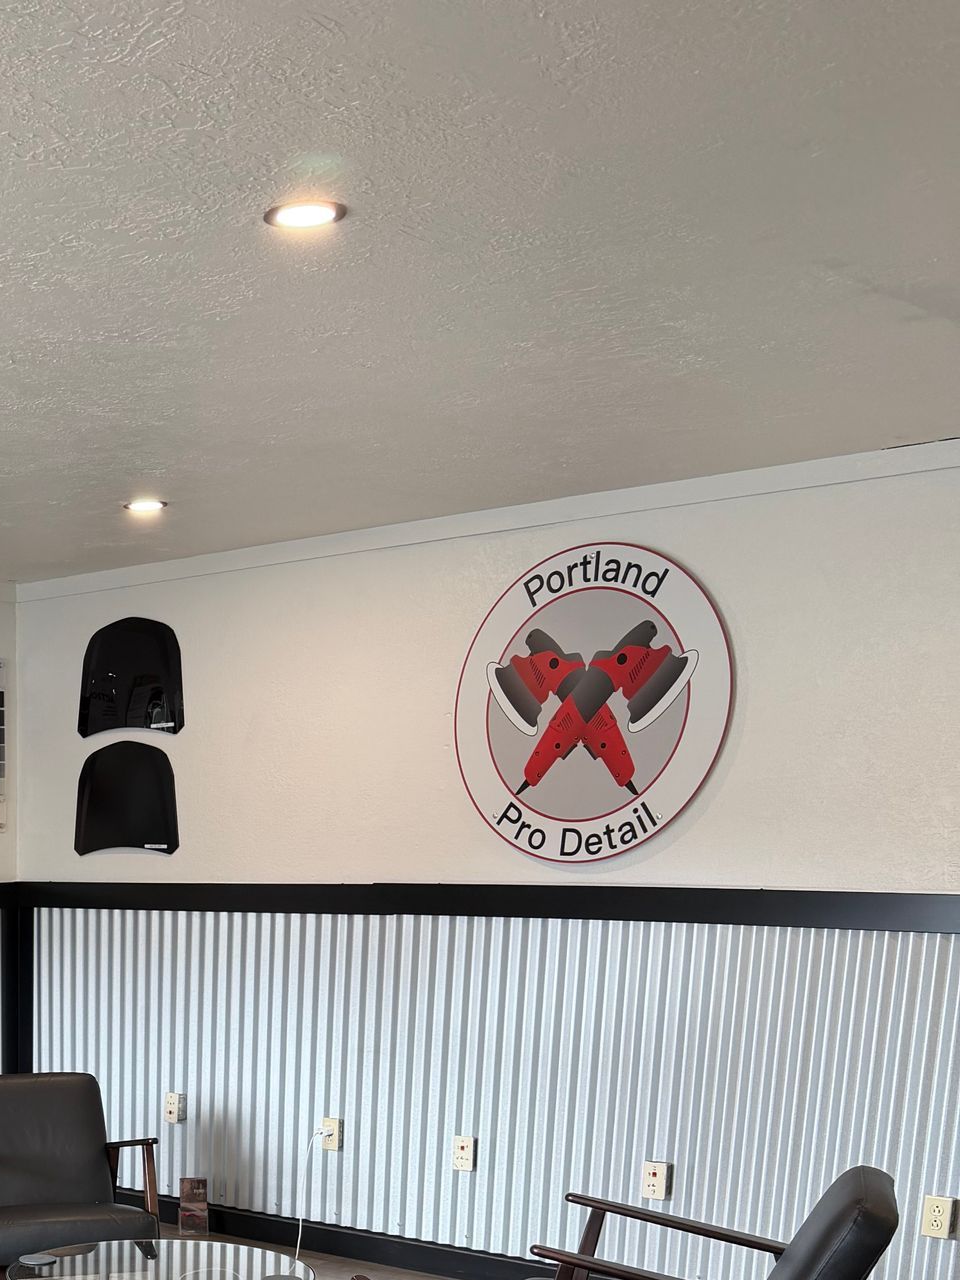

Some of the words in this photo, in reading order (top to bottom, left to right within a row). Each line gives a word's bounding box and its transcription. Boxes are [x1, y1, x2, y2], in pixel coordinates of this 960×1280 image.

[524, 550, 670, 607] Portland
[496, 802, 546, 850] Pro
[559, 802, 659, 857] Detail
